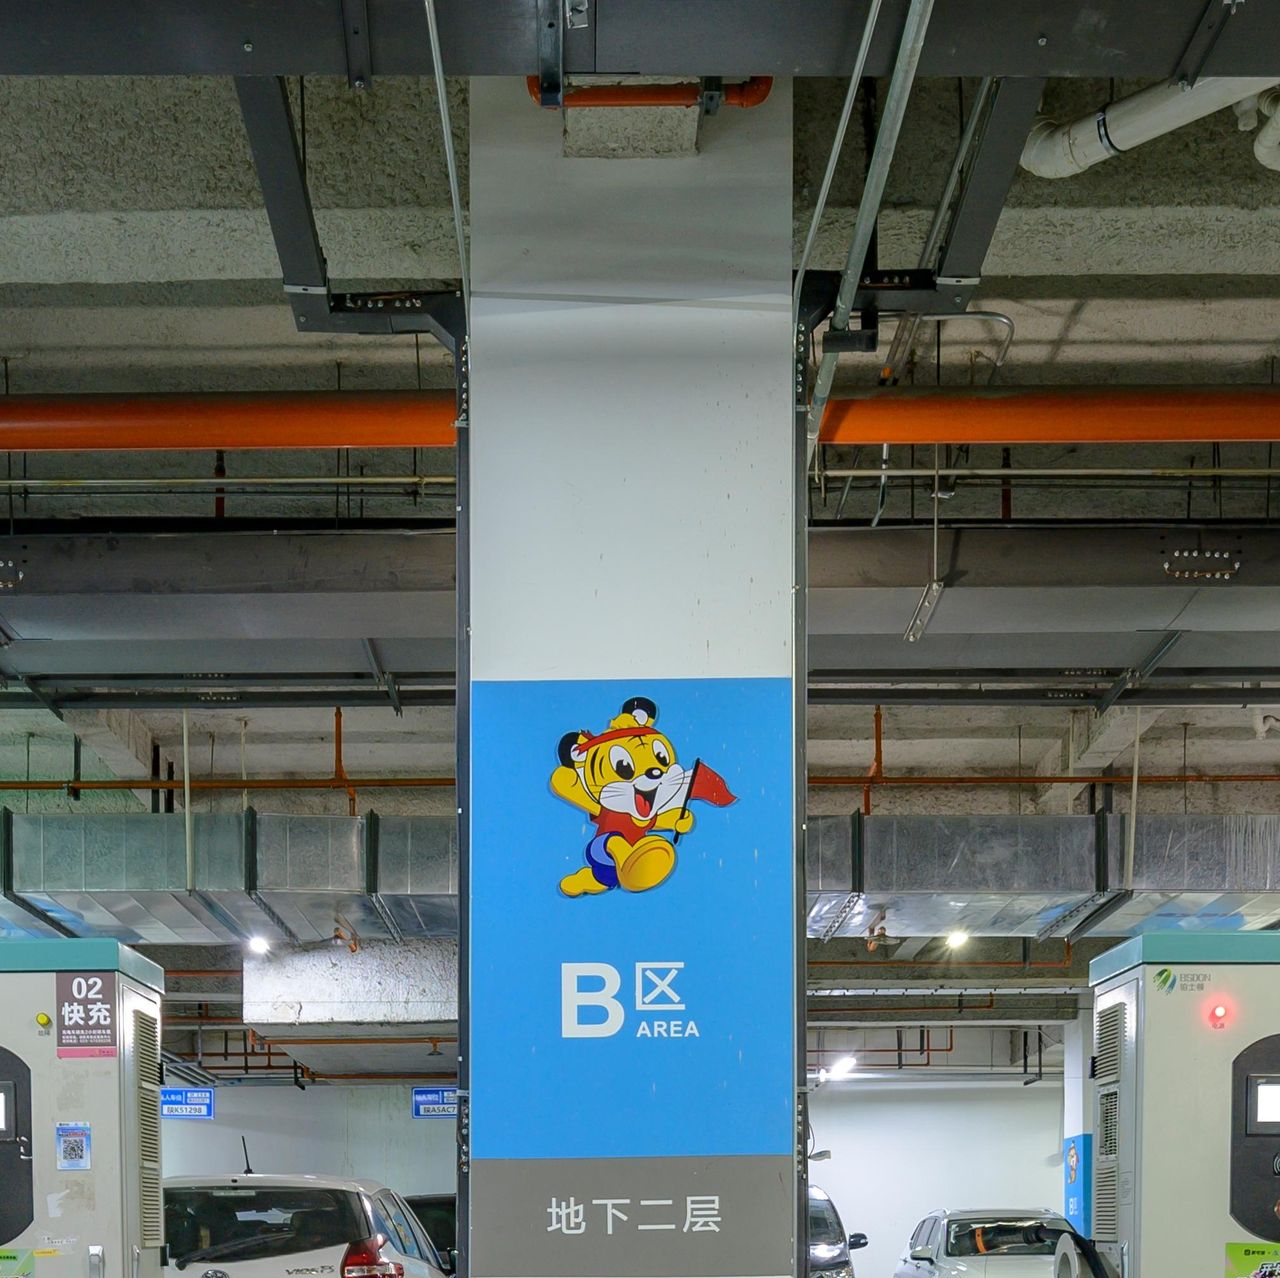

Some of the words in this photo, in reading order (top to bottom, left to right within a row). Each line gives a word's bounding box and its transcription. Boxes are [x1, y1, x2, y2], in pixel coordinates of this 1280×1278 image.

[72, 977, 102, 998] 02
[562, 962, 686, 1038] B区
[62, 1002, 110, 1025] 快充
[636, 1021, 700, 1038] AREA
[547, 1195, 721, 1234] 地下二层
